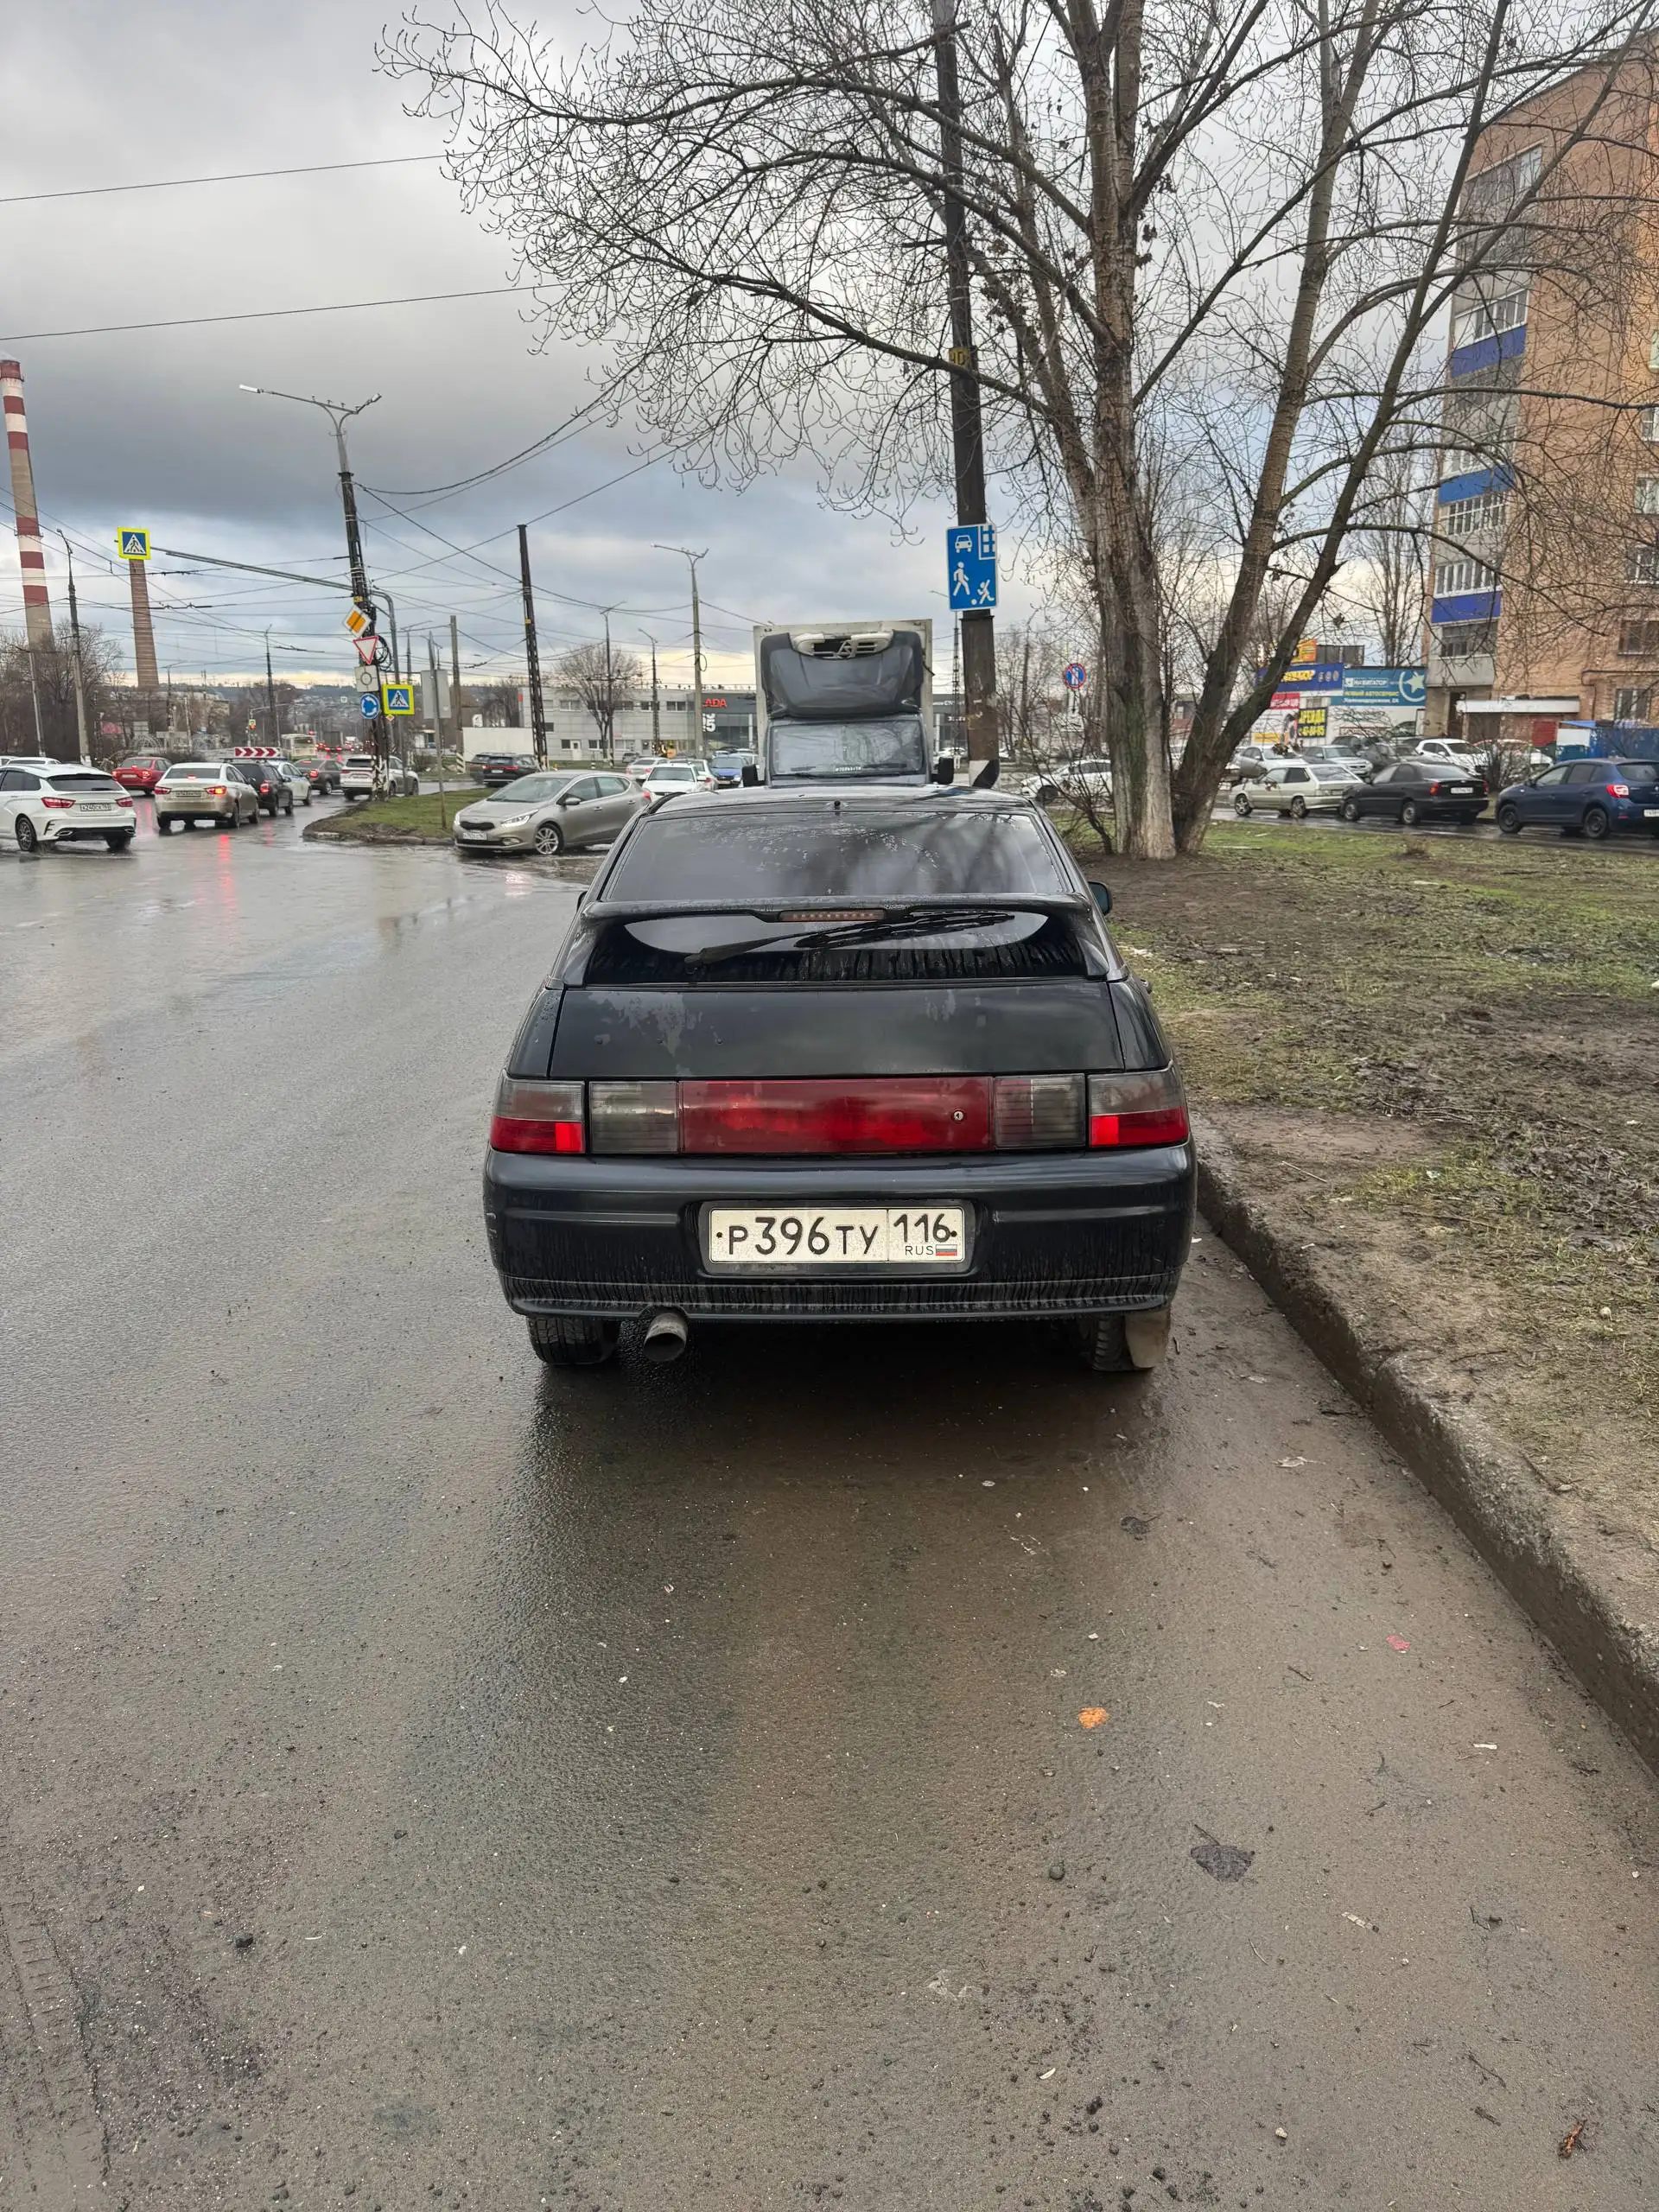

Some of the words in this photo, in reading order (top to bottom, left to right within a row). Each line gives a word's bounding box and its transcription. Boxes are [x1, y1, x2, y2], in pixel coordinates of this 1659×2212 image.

[728, 1217, 878, 1255] Р396ТУ
[893, 1213, 950, 1243] 116
[905, 1245, 934, 1256] RUS
